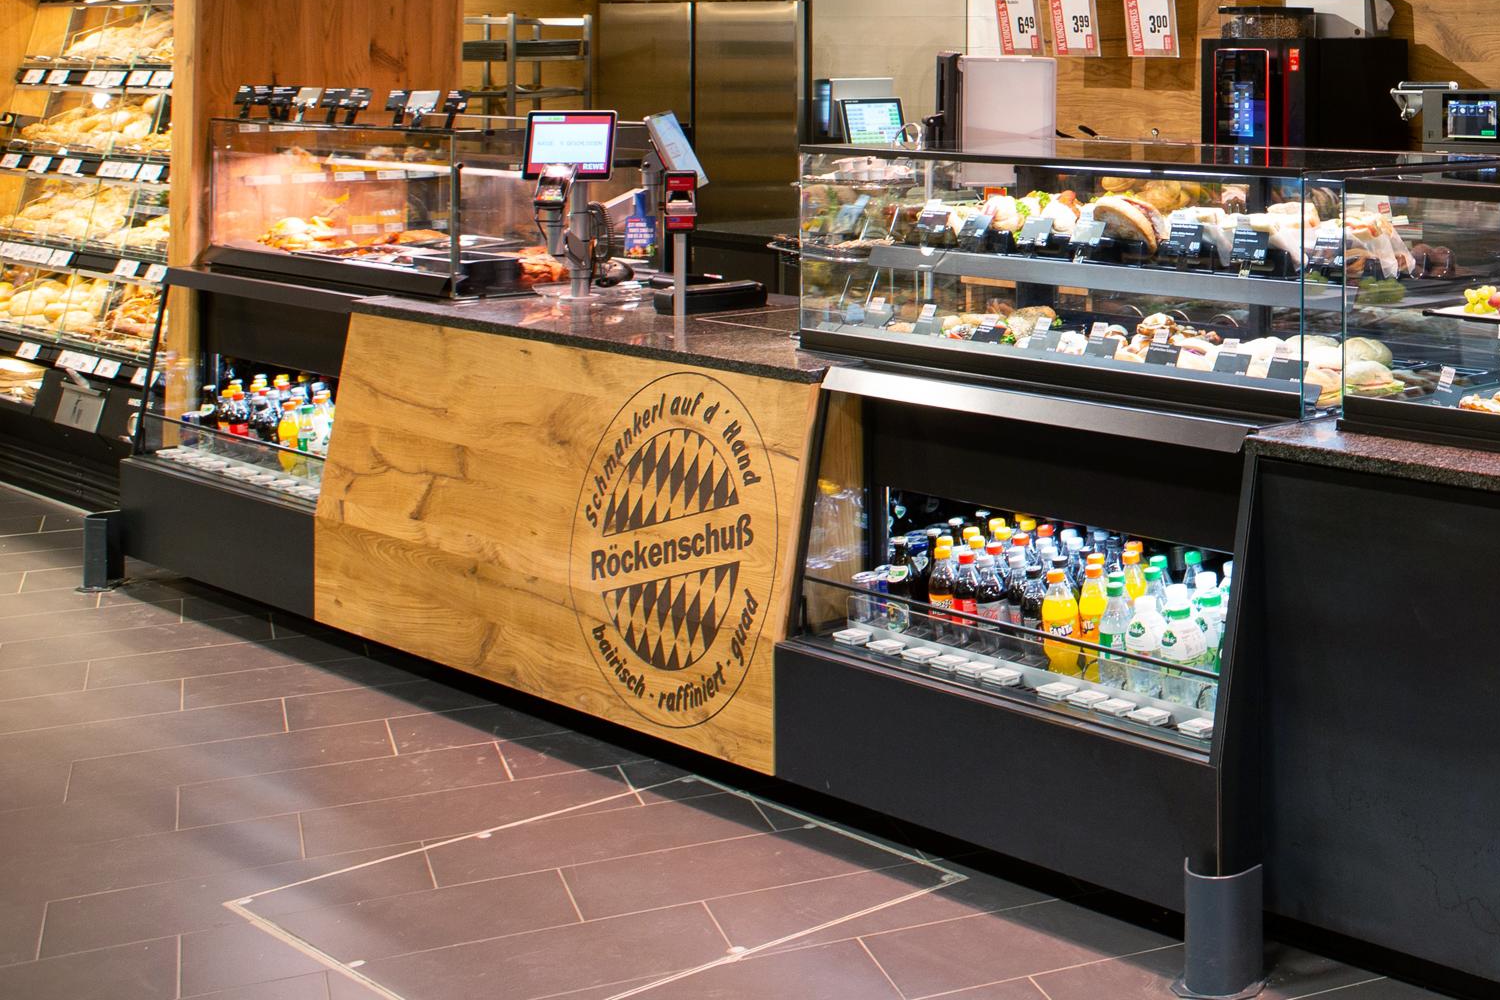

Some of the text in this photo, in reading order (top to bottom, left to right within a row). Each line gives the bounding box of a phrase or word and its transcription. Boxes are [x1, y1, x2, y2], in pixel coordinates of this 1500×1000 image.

[1017, 16, 1035, 34] 6.49
[1072, 15, 1090, 33] 3.99
[1149, 15, 1168, 33] 3.00
[585, 393, 667, 528] Schmankerl
[670, 391, 704, 417] auf
[723, 420, 761, 488] Hand
[591, 514, 754, 581] Röckenschuß
[592, 588, 760, 713] bairisch raffiniert guad
